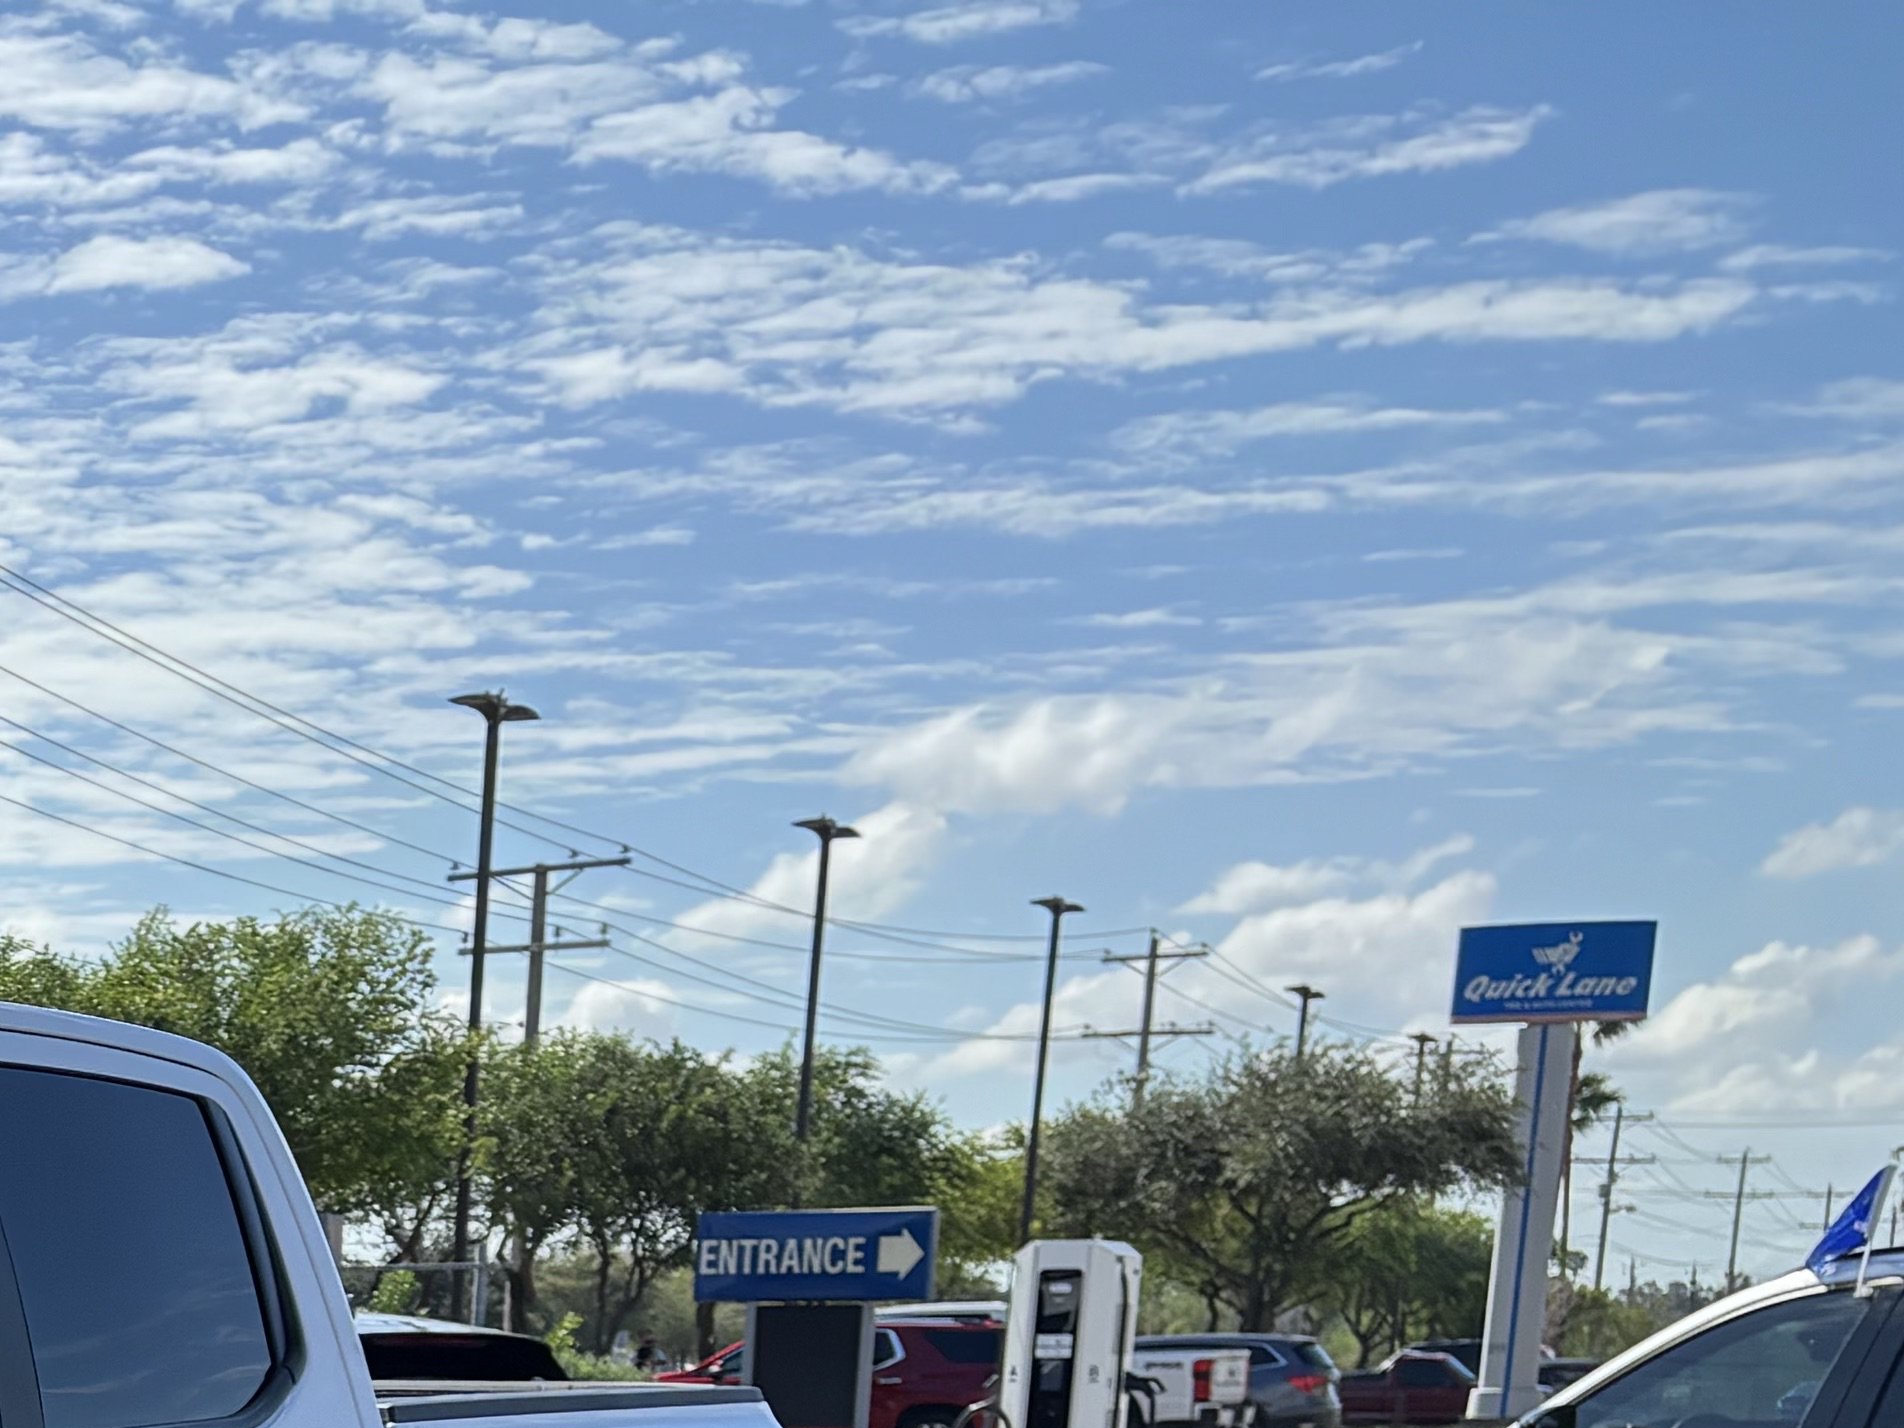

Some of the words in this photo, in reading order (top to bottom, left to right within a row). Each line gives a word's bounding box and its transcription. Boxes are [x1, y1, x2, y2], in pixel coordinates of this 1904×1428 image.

[1464, 972, 1554, 1003] Quick
[1555, 971, 1638, 997] Lane
[698, 1237, 866, 1275] ENTRANCE
